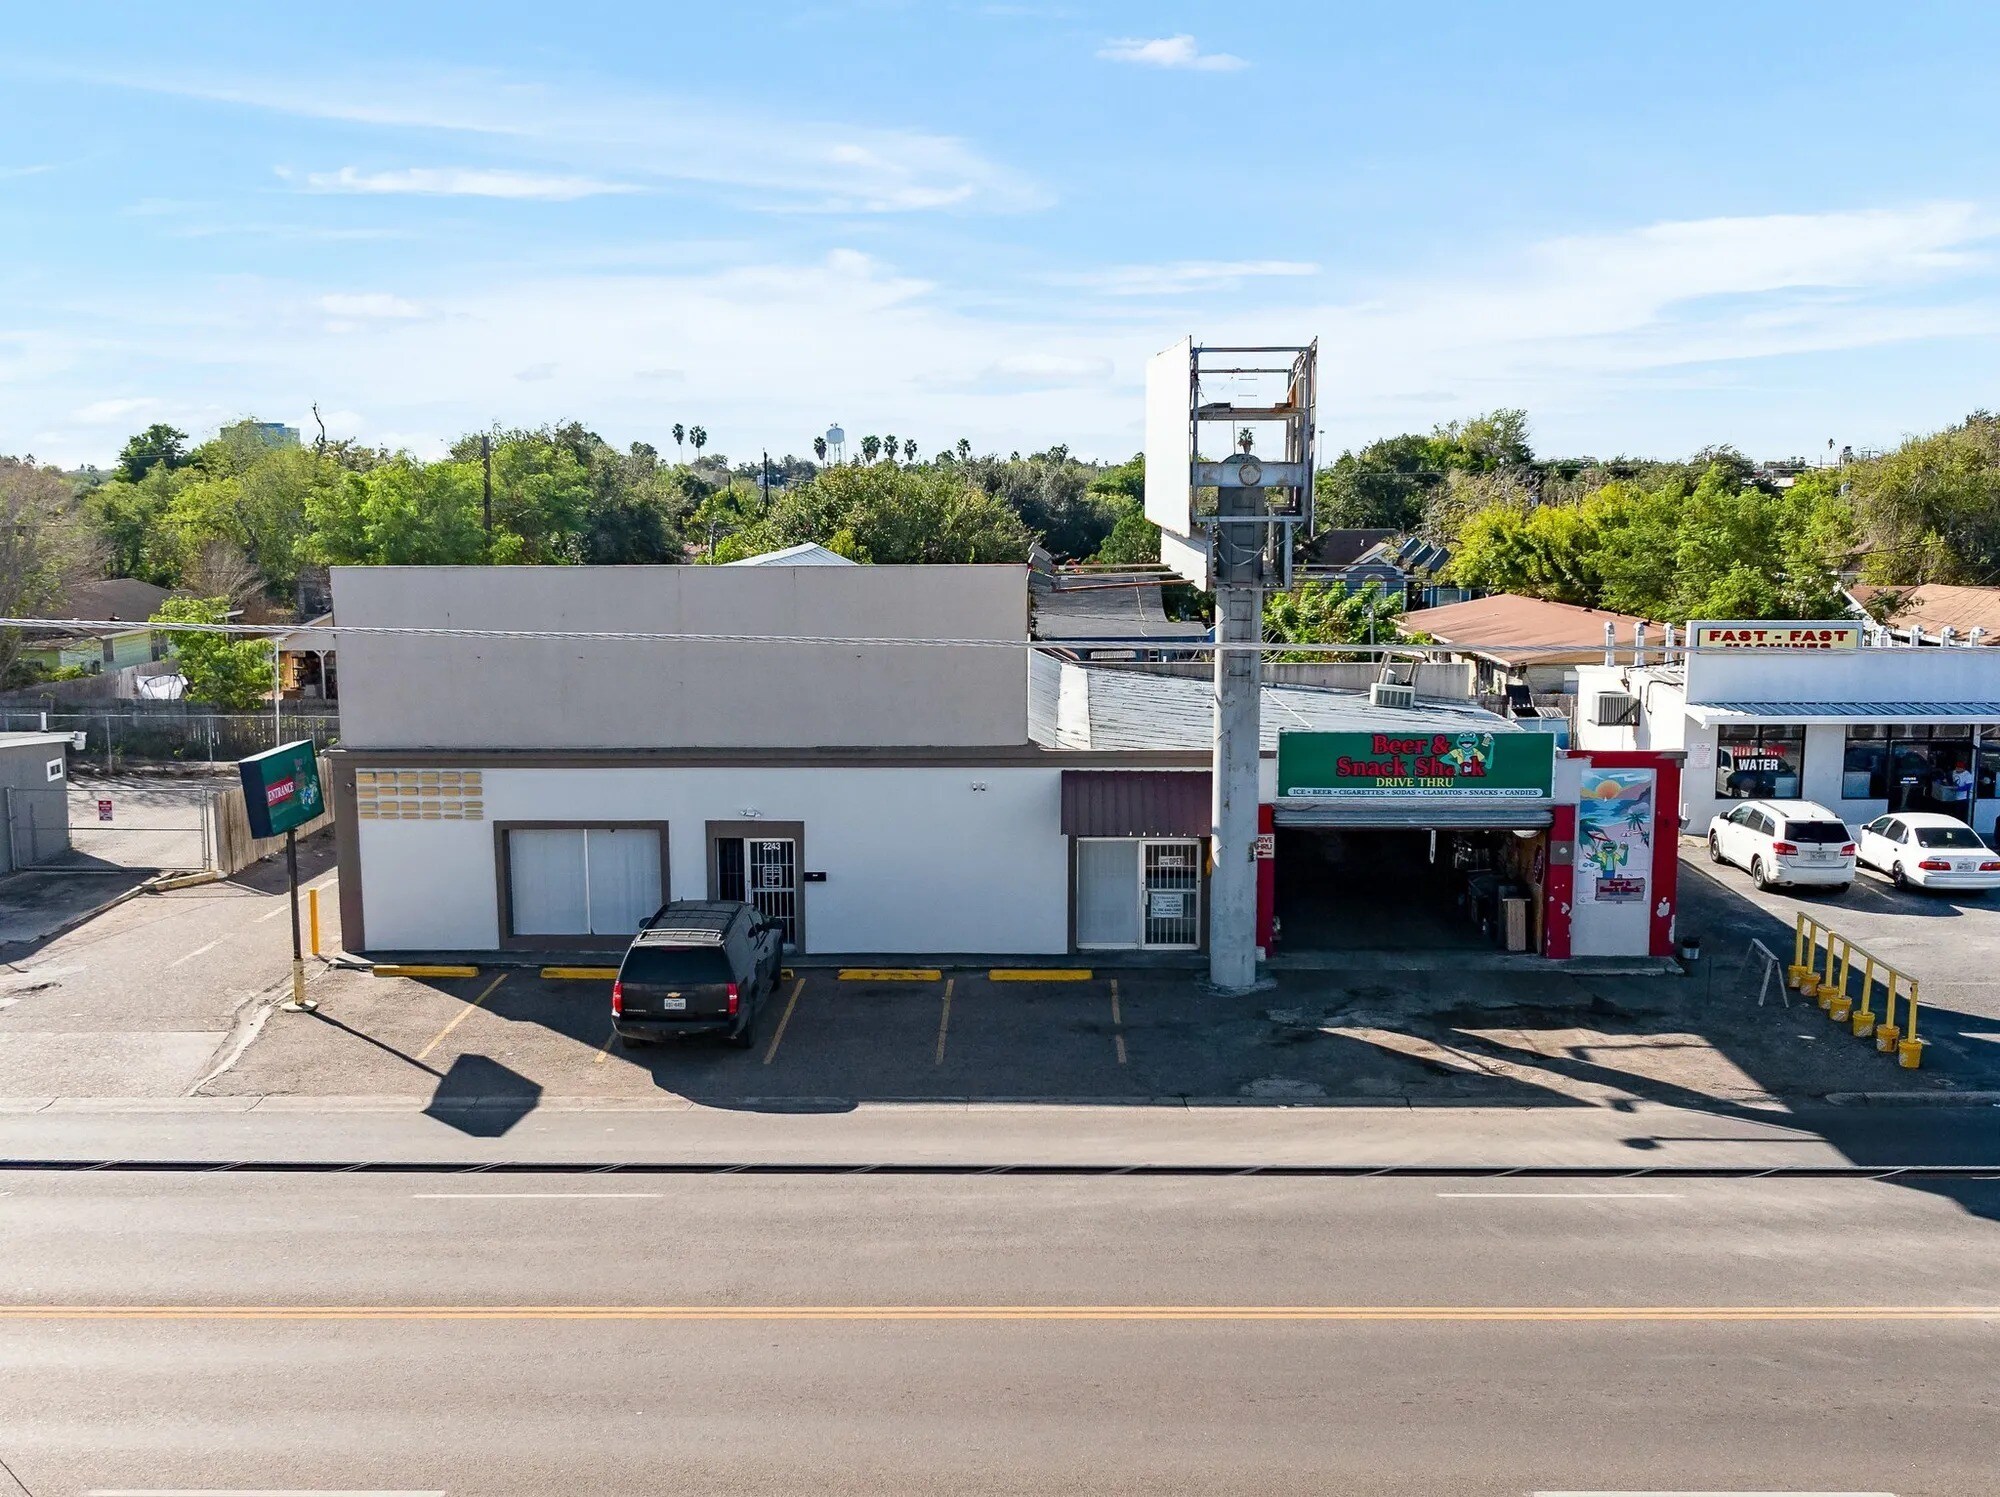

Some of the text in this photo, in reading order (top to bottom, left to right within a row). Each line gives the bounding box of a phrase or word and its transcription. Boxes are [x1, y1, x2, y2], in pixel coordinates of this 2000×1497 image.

[1709, 630, 1768, 642] FAST
[1789, 630, 1848, 642] FAST
[1372, 733, 1452, 755] Beer &
[1336, 756, 1407, 777] Snack
[1738, 759, 1779, 771] WATER
[1376, 777, 1454, 787] DRIVE THRU
[267, 781, 295, 802] ENTRANCE
[762, 842, 781, 850] 2243
